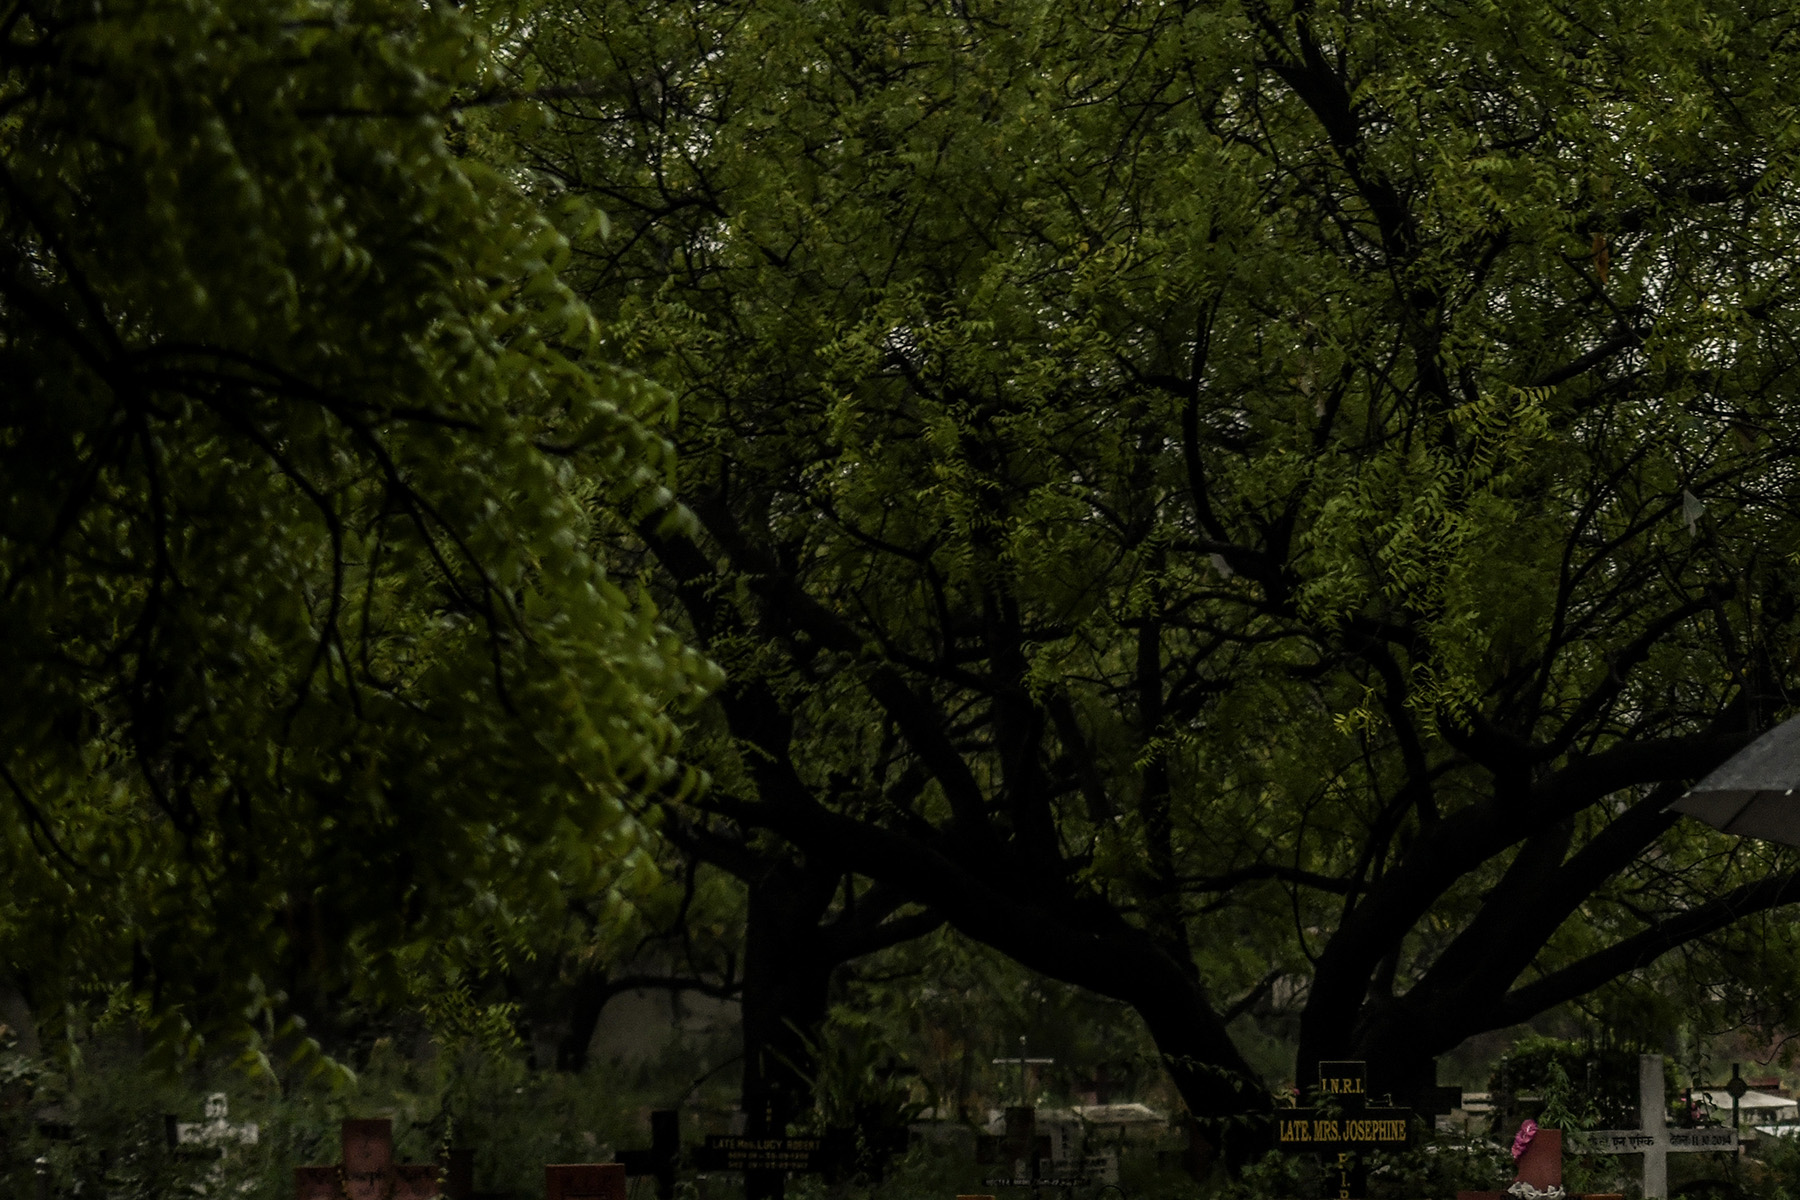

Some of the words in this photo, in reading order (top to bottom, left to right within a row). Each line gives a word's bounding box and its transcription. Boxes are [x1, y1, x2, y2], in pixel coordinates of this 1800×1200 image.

[1280, 1120, 1312, 1142] LATE.
[1313, 1120, 1342, 1142] MRS.
[1342, 1120, 1407, 1142] JOSEPHINE
